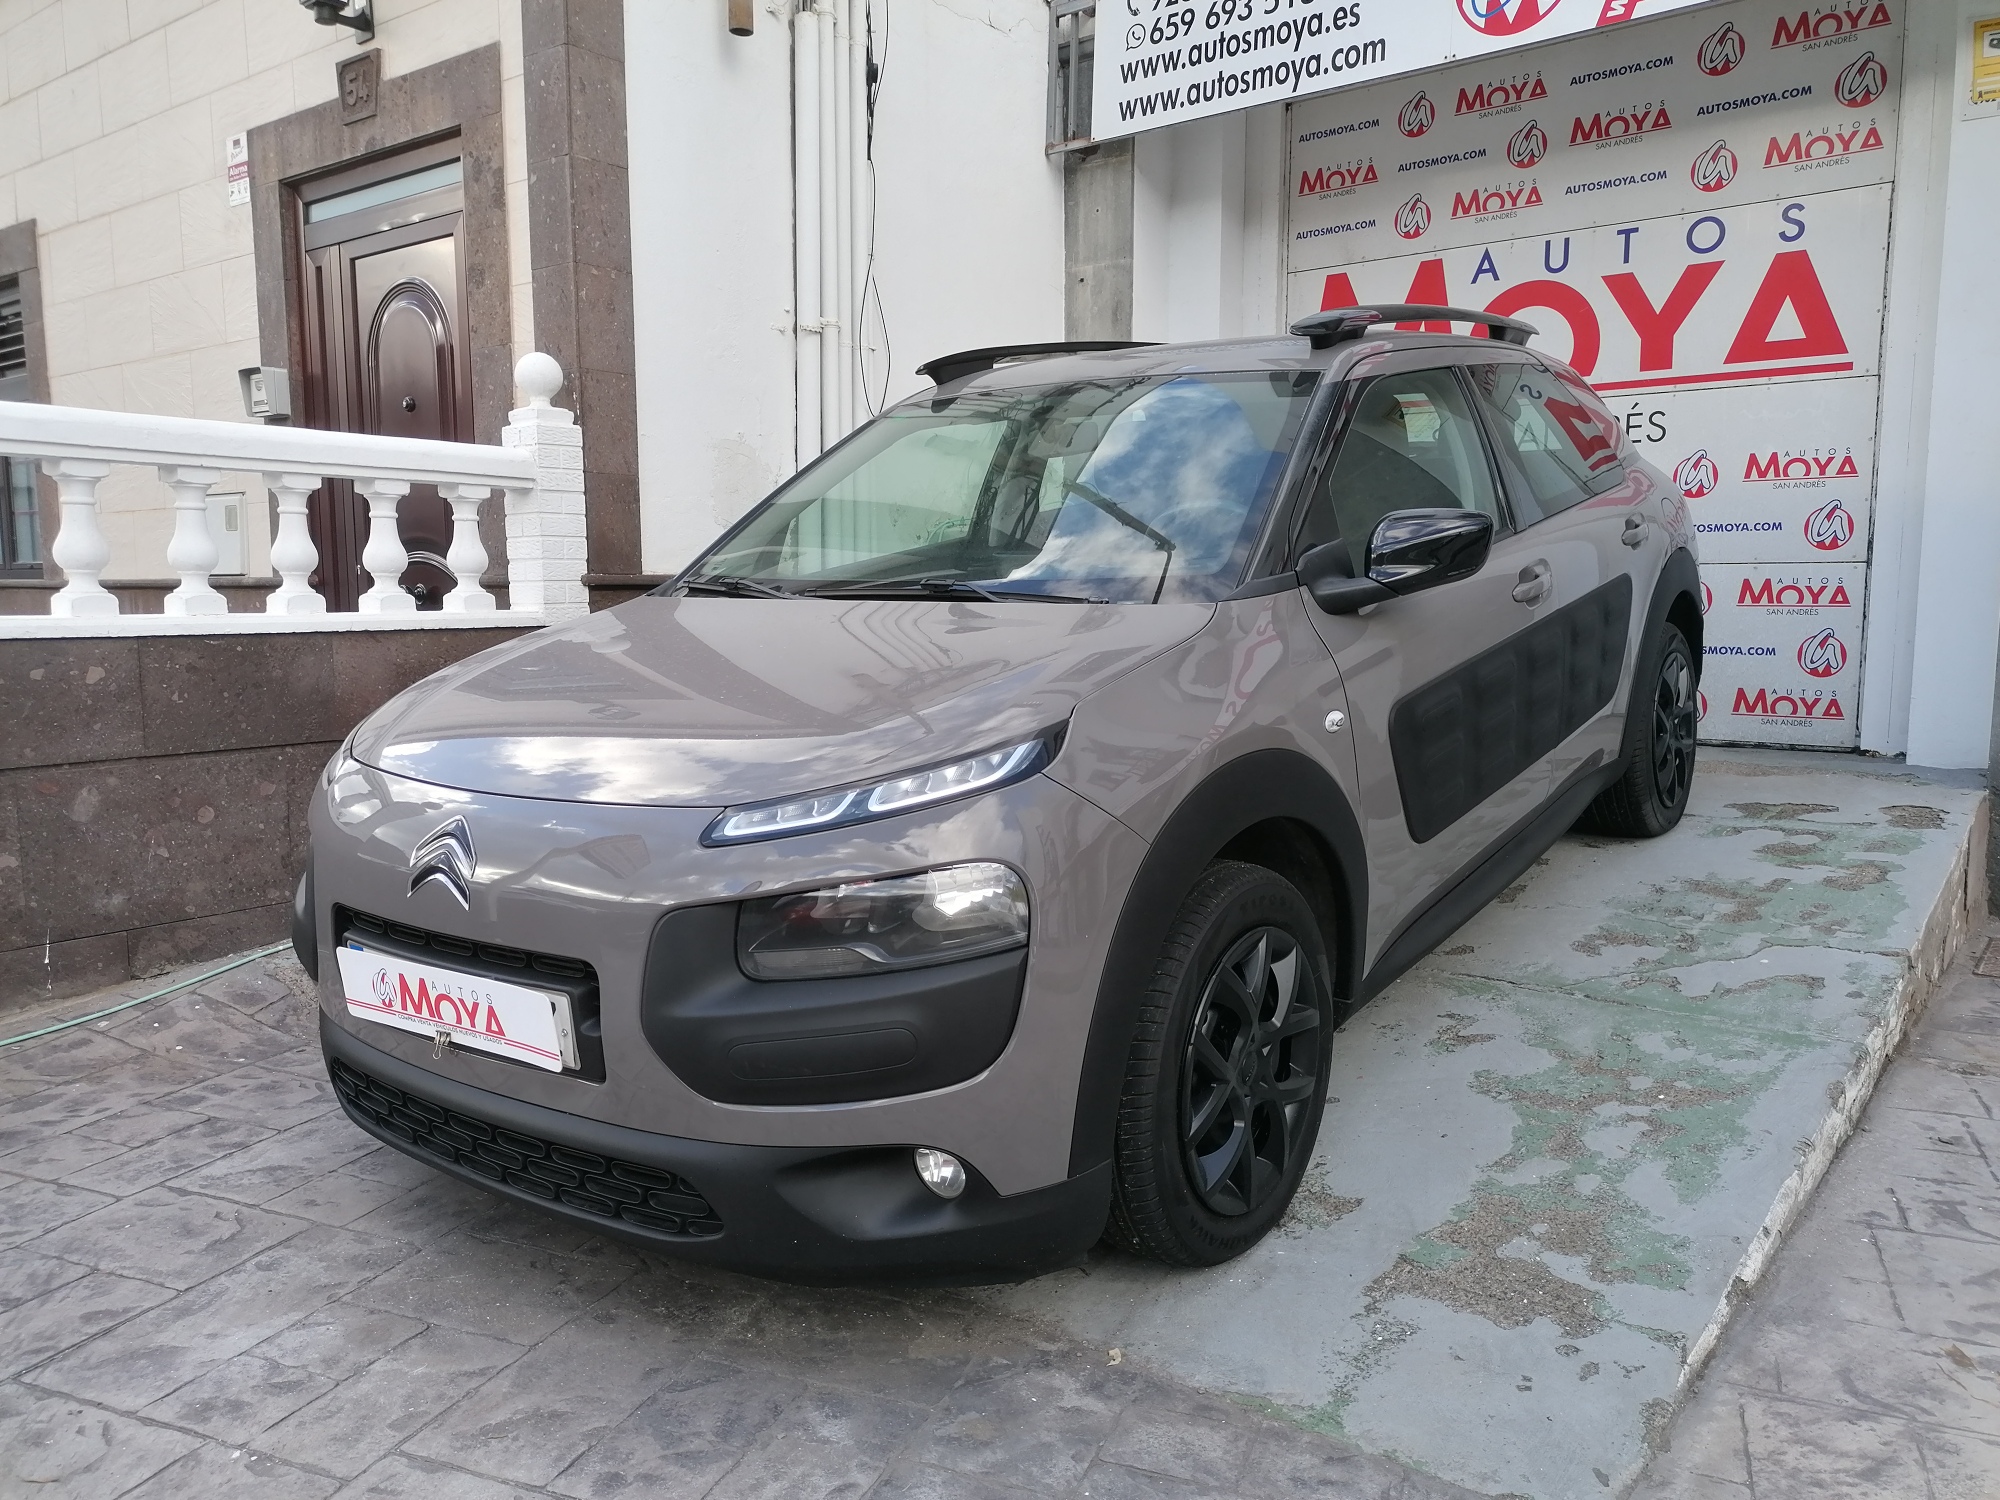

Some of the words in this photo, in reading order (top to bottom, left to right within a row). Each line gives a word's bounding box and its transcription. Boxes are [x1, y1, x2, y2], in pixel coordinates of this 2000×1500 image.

[1150, 8, 1196, 45] 659
[1771, 2, 1892, 47] MOYA
[1119, 2, 1361, 84] www.autosmoya.es
[1801, 41, 1822, 52] SAN
[1823, 33, 1859, 48] ANDRÉS
[1118, 37, 1387, 122] www.autosmoya.com
[1486, 70, 1542, 89] AUTOS
[1569, 55, 1674, 87] AUTOSMOYA.COM
[1455, 77, 1549, 114] MOYA
[1696, 84, 1813, 117] AUTOSMOYA.COM
[1478, 111, 1494, 120] SAN
[1494, 104, 1522, 116] ANDRÉS
[1604, 99, 1666, 118] AUTOS
[1298, 119, 1380, 143] AUTOSMOYA.COM
[1569, 107, 1672, 144] MOYA
[1805, 117, 1876, 138] AUTOS
[1595, 141, 1612, 151] SAN
[1613, 134, 1643, 148] ANDRÉS
[1763, 126, 1884, 166] MOYA
[1325, 156, 1374, 173] AUTOS
[1397, 148, 1488, 173] AUTOSMOYA.COM
[1794, 162, 1813, 173] SAN
[1814, 155, 1850, 170] ANDRÉS
[1298, 164, 1379, 195] MOYA
[1482, 178, 1537, 194] AUTOS
[1564, 170, 1668, 196] AUTOSMOYA.COM
[1318, 192, 1332, 201] SAN
[1332, 187, 1357, 199] ANDRÉS
[1451, 185, 1543, 217] MOYA
[1474, 215, 1489, 224] SAN
[1490, 211, 1518, 223] ANDRÉS
[1295, 219, 1376, 241] AUTOSMOYA.COM
[1470, 202, 1806, 284] AUTOS
[1783, 446, 1851, 458] AUTOS
[1743, 451, 1859, 480] MOYA
[1772, 482, 1791, 490] SAN
[1792, 479, 1826, 489] ANDRÉS
[1693, 521, 1783, 533] OSMOYA.COM
[1737, 578, 1851, 605] MOYA
[1776, 577, 1844, 585] AUTOS
[1765, 608, 1784, 616] SAN
[1785, 606, 1819, 616] ANDRÉS
[1701, 646, 1776, 656] SMOYA.COM
[1732, 687, 1844, 718] MOYA
[1770, 688, 1837, 697] AUTOS
[1760, 718, 1778, 726] SAN
[1779, 718, 1813, 727] ANDRÉS
[430, 980, 493, 1005] AUTOS
[398, 972, 506, 1037] MOYA
